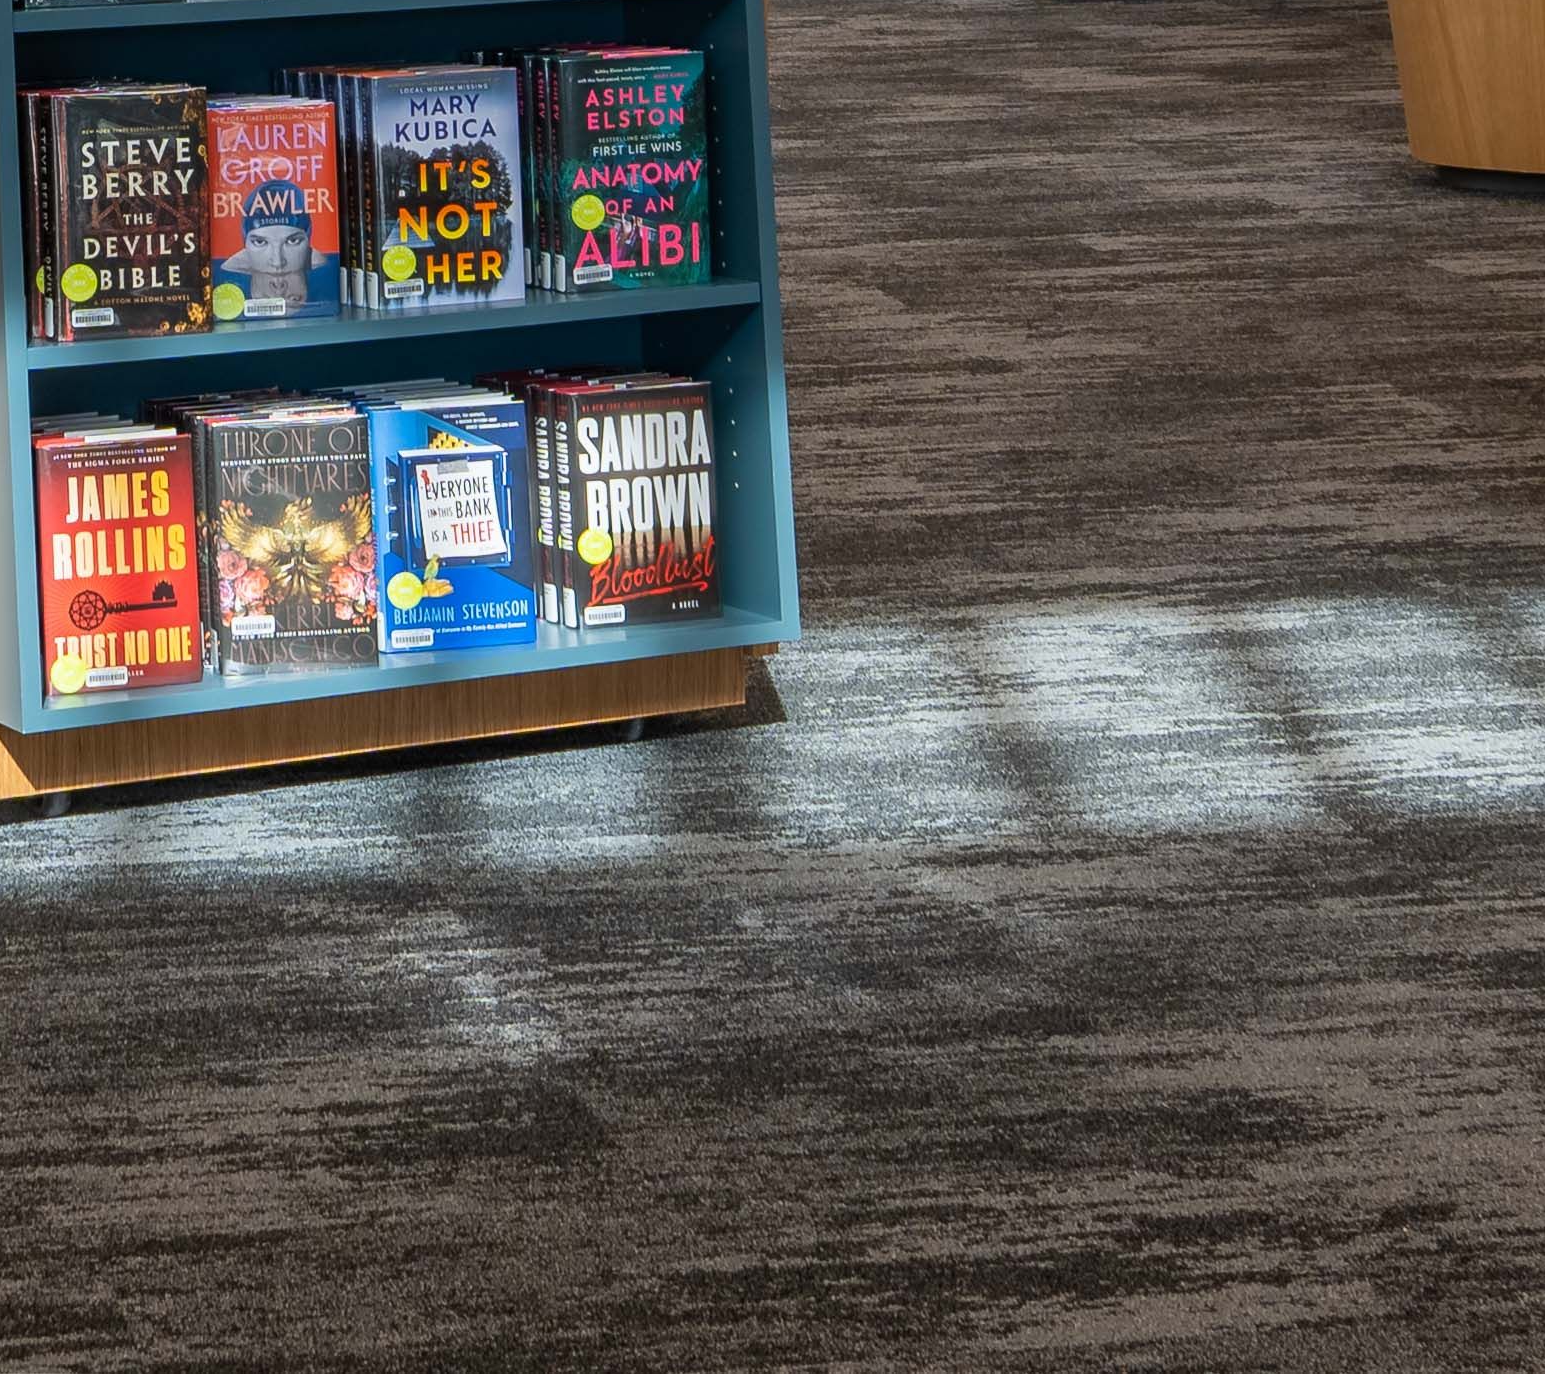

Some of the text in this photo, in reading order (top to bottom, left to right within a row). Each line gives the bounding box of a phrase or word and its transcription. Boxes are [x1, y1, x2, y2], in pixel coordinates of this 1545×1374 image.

[410, 93, 480, 116] MARY
[585, 84, 685, 108] ASHLEY
[395, 118, 497, 143] KUBICA
[587, 107, 685, 130] ELSTON
[216, 122, 327, 152] LAUREN
[593, 141, 682, 156] FIRST LIE WINS
[82, 137, 191, 168] STEVE
[82, 169, 194, 200] BERRY
[221, 155, 324, 185] GROFF
[419, 157, 491, 192] IT'S
[572, 159, 703, 190] ANATOMY
[213, 187, 334, 220] BRAWLER
[605, 196, 674, 216] OF AN
[123, 213, 153, 225] THE
[399, 202, 497, 243] NOT
[84, 233, 196, 260] DEVIL'S
[574, 222, 700, 269] ALIBI
[100, 265, 181, 290] BIBLE
[427, 251, 503, 284] HER
[577, 409, 711, 475] SANDRA
[221, 462, 367, 497] NIGHTMARES
[425, 476, 489, 501] EVERYONE
[66, 470, 170, 524] JAMES
[438, 508, 453, 518] THIS
[455, 500, 492, 519] BANK
[586, 471, 711, 534] BROWN
[431, 520, 495, 546] IS A THIEF
[52, 524, 187, 581] ROLLINS
[394, 600, 528, 625] BENJAMIN STEVENSON
[54, 627, 192, 668] TRUST NO ONE
